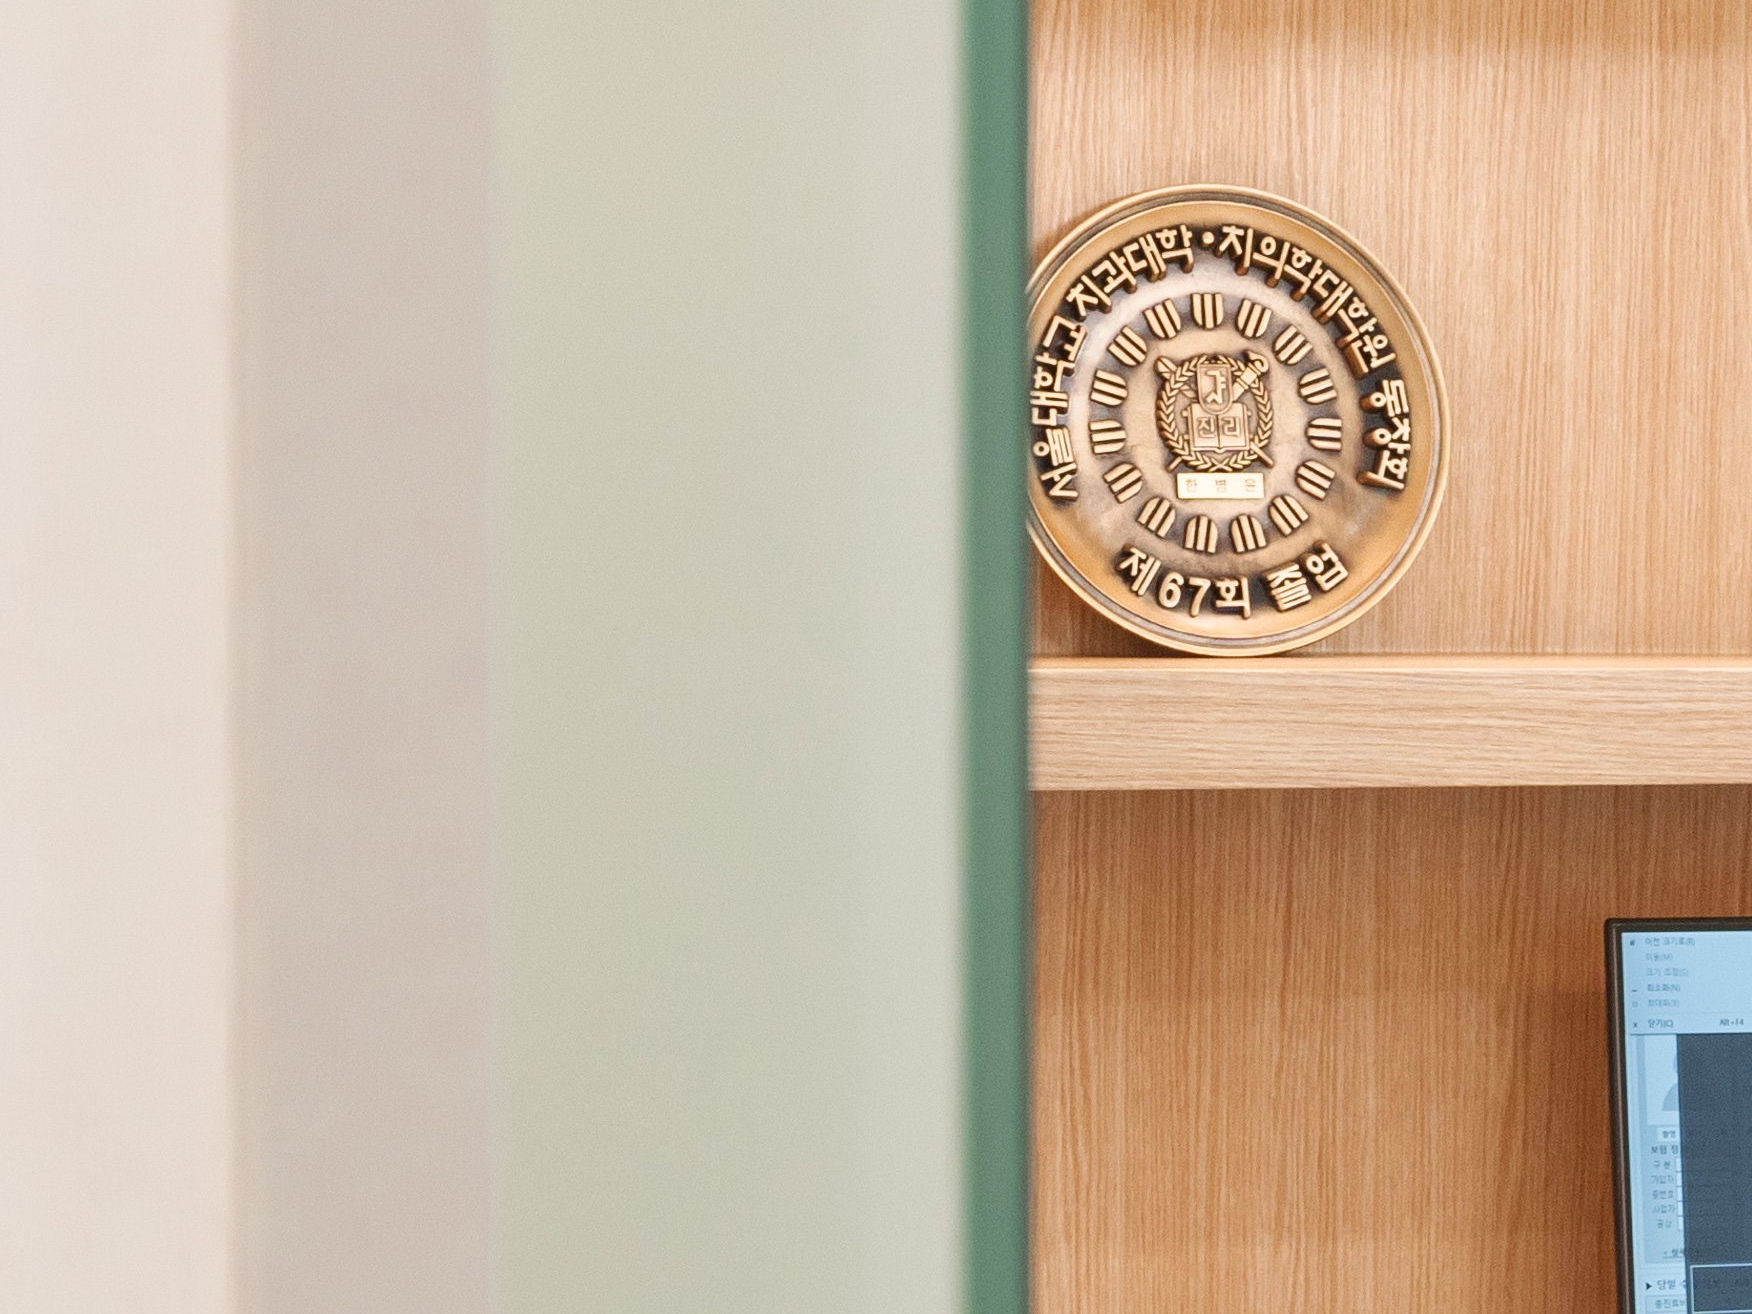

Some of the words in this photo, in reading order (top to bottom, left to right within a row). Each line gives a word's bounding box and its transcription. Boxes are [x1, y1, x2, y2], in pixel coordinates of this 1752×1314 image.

[1031, 314, 1087, 500] 서울대학교
[1359, 378, 1411, 490] 동창회
[1118, 543, 1251, 619] 제67회
[1265, 541, 1349, 612] 졸업
[1720, 1019, 1744, 1027] Alt+F4
